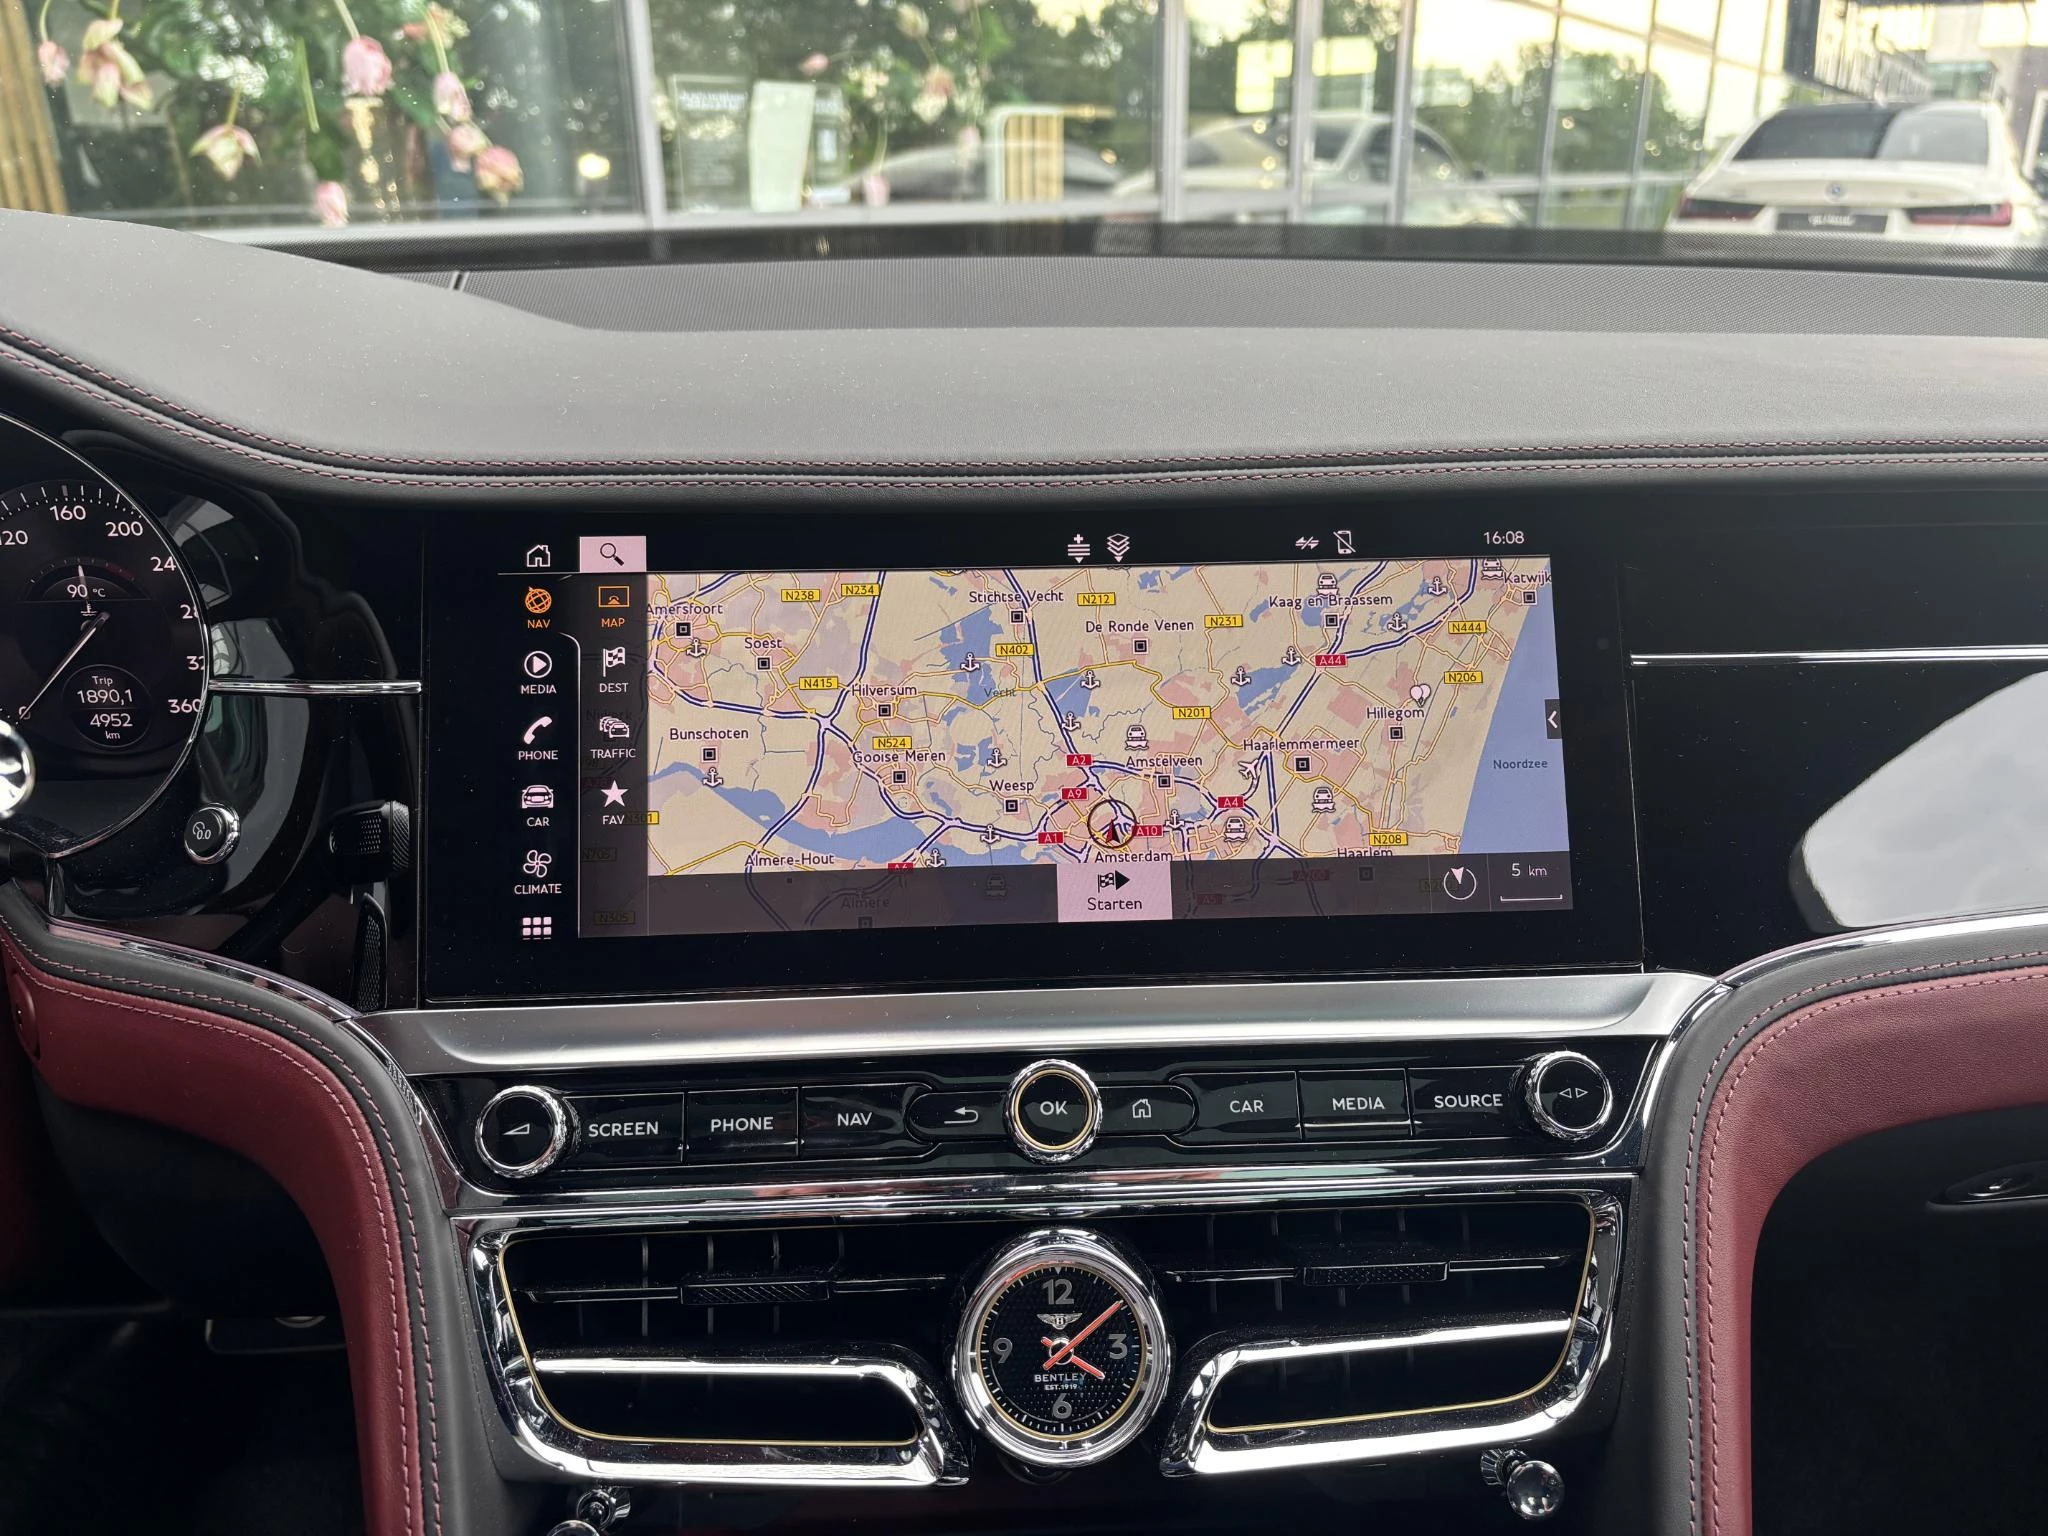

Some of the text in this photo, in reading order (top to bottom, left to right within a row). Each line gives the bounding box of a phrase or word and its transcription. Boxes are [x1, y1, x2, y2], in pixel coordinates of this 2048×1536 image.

[50, 505, 86, 521] 160
[105, 521, 143, 537] 200
[1483, 531, 1525, 545] 16:08
[1503, 573, 1551, 585] Katwijk
[67, 584, 88, 598] 90
[785, 591, 815, 600] N238
[845, 586, 874, 595] N234
[969, 590, 1064, 603] Stichtse Vecht
[1082, 595, 1110, 604] N212
[1269, 595, 1392, 609] Kaag en Braassem
[647, 604, 723, 615] Amersfoort
[527, 619, 551, 629] NAV
[601, 618, 625, 628] MAP
[1085, 620, 1194, 632] De Ronde Venen
[1210, 617, 1237, 626] N231
[1453, 623, 1481, 632] N444
[744, 638, 782, 649] Soest
[1000, 645, 1028, 654] N402
[1320, 655, 1342, 665] A44
[92, 676, 113, 686] Trip
[803, 679, 832, 688] N415
[1449, 673, 1476, 682] N206
[520, 684, 557, 695] MEDIA
[599, 682, 628, 693] DEST
[851, 685, 917, 696] Hilversum
[984, 688, 1016, 698] Vecht
[77, 689, 133, 705] 1890,1
[168, 698, 202, 714] 360
[1178, 708, 1206, 717] N201
[1367, 707, 1424, 720] Hillegom
[90, 713, 133, 728] 4952
[105, 731, 120, 740] km
[669, 728, 749, 740] Bunschoten
[878, 738, 906, 747] N524
[1243, 738, 1359, 751] Haarlemmermeer
[518, 750, 559, 761] PHONE
[590, 749, 636, 759] TRAFFIC
[852, 751, 946, 763] Gooise Meren
[1126, 756, 1203, 768] Amstelveen
[1493, 758, 1547, 769] Noordzee
[989, 780, 1034, 794] Weesp
[526, 817, 550, 827] CAR
[602, 815, 625, 825] FAV
[1136, 825, 1158, 836] A10
[1373, 835, 1402, 844] N208
[1095, 851, 1173, 864] Amsterdam
[1337, 847, 1393, 858] Haarlem
[745, 853, 834, 867] Almere-Hout
[1511, 864, 1547, 876] 5 km
[514, 884, 562, 895] CLIMATE
[1087, 898, 1142, 911] Starten
[1229, 1100, 1264, 1113] CAR
[1332, 1097, 1385, 1111] MEDIA
[1434, 1093, 1503, 1108] SOURCE
[1040, 1101, 1068, 1115] OK
[710, 1117, 774, 1132] PHONE
[837, 1112, 872, 1126] NAV
[588, 1122, 659, 1137] SCREEN
[1042, 1279, 1075, 1305] 12
[992, 1337, 1013, 1364] 9
[1108, 1334, 1128, 1360] 3
[1034, 1373, 1087, 1383] BENTLEY
[1052, 1393, 1073, 1419] 6
